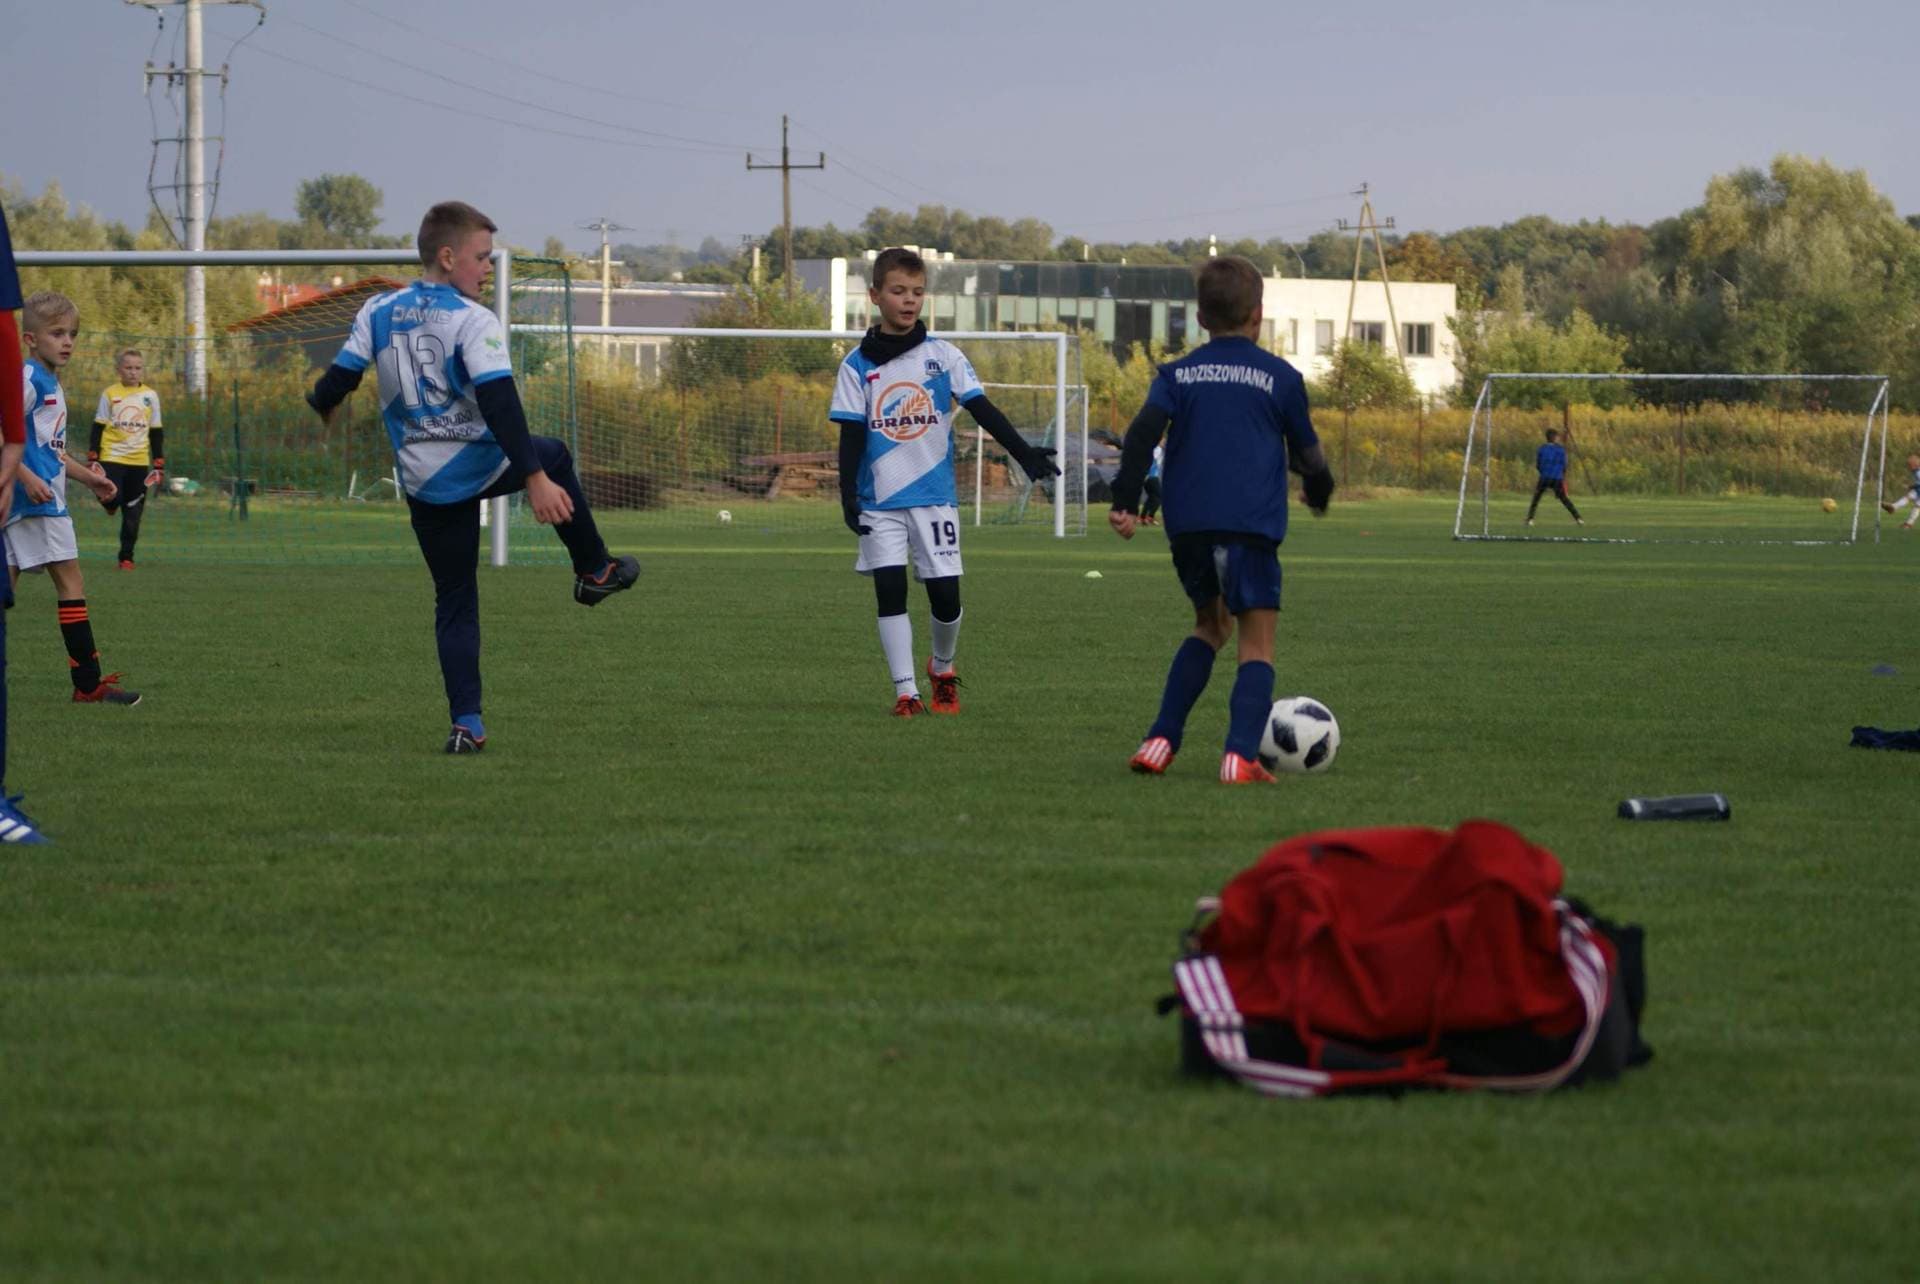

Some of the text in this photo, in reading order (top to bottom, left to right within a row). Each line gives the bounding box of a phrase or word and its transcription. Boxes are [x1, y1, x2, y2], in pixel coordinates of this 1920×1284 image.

[390, 332, 449, 409] 13
[1175, 364, 1274, 394] RADZISZOWIANKA
[871, 415, 939, 429] GRANA
[931, 520, 956, 546] 19
